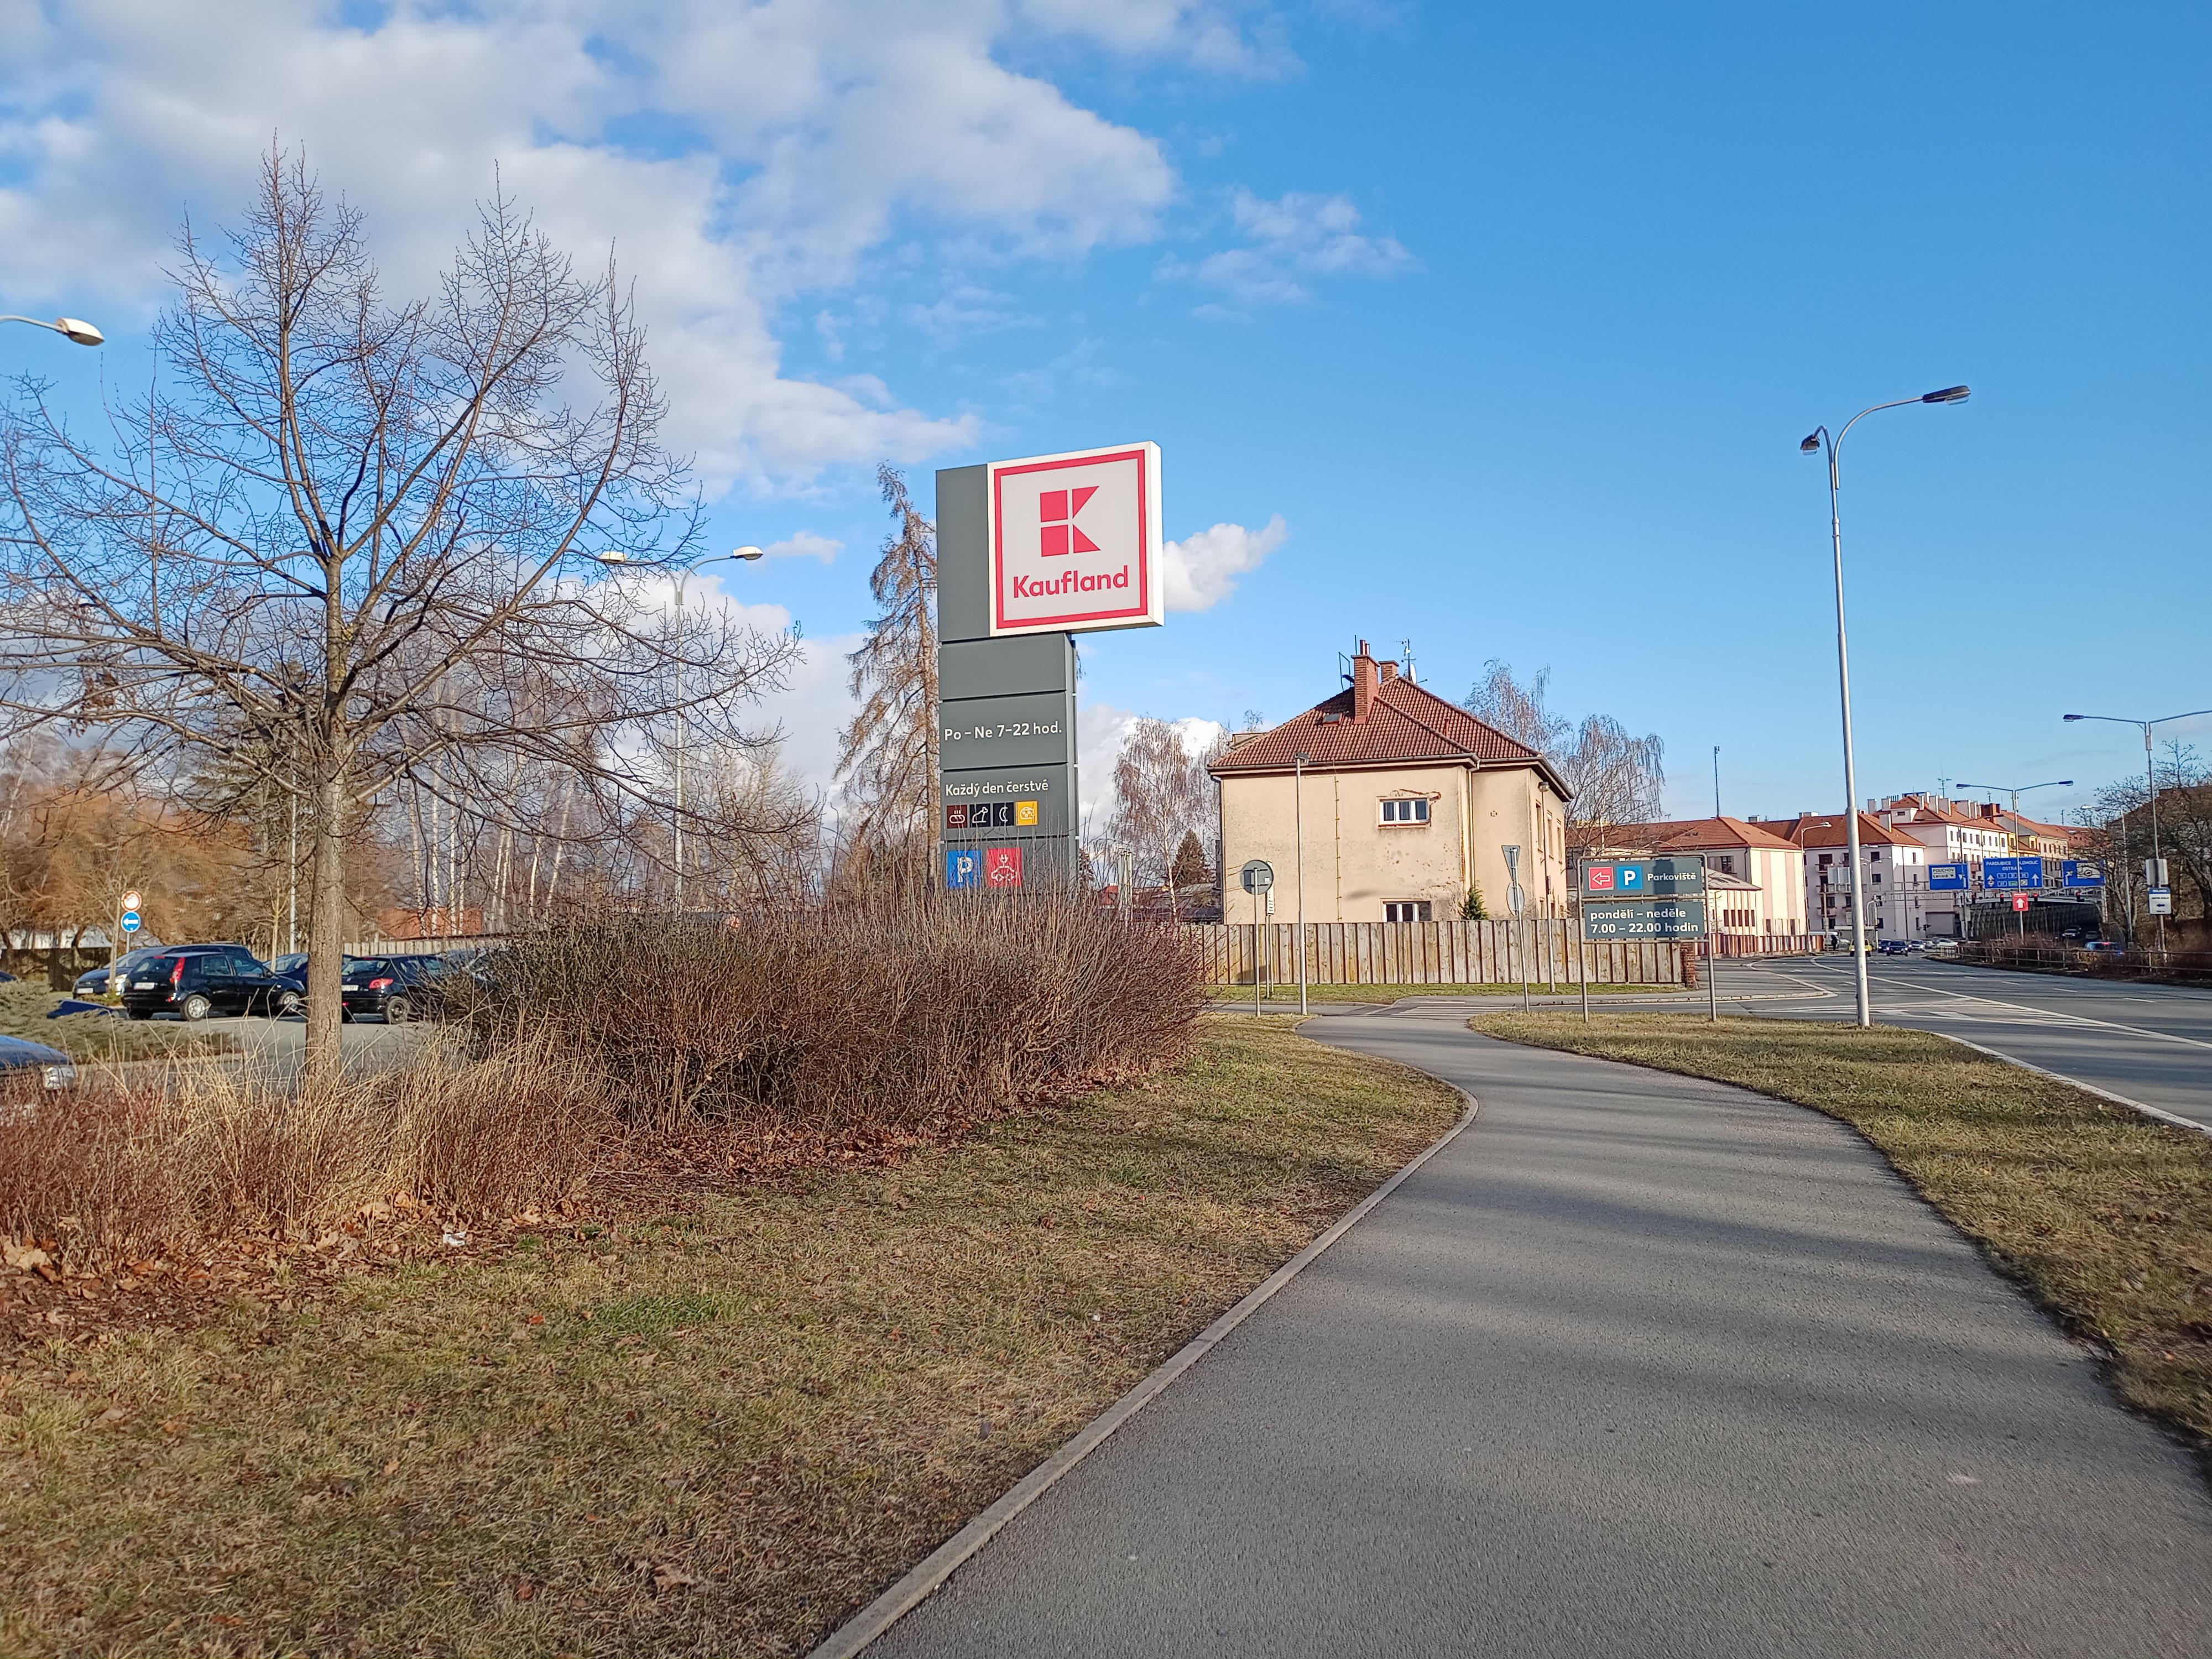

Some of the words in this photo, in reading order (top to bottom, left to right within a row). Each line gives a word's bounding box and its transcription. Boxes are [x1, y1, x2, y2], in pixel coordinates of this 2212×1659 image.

[1014, 565, 1128, 598] Kaufland
[945, 728, 962, 740] Po
[974, 726, 993, 739] Ne
[1033, 721, 1062, 735] hod.
[946, 783, 980, 797] Každý
[982, 781, 1004, 794] den
[1006, 779, 1049, 792] čerstvé
[957, 856, 973, 883] P
[1624, 870, 1636, 886] P
[1647, 872, 1696, 881] Parkoviště
[1590, 909, 1634, 922] pondělí
[1646, 907, 1686, 918] neděle
[1590, 924, 1616, 933] 7.00
[1629, 923, 1662, 933] 22.00
[1665, 922, 1699, 932] hodin
